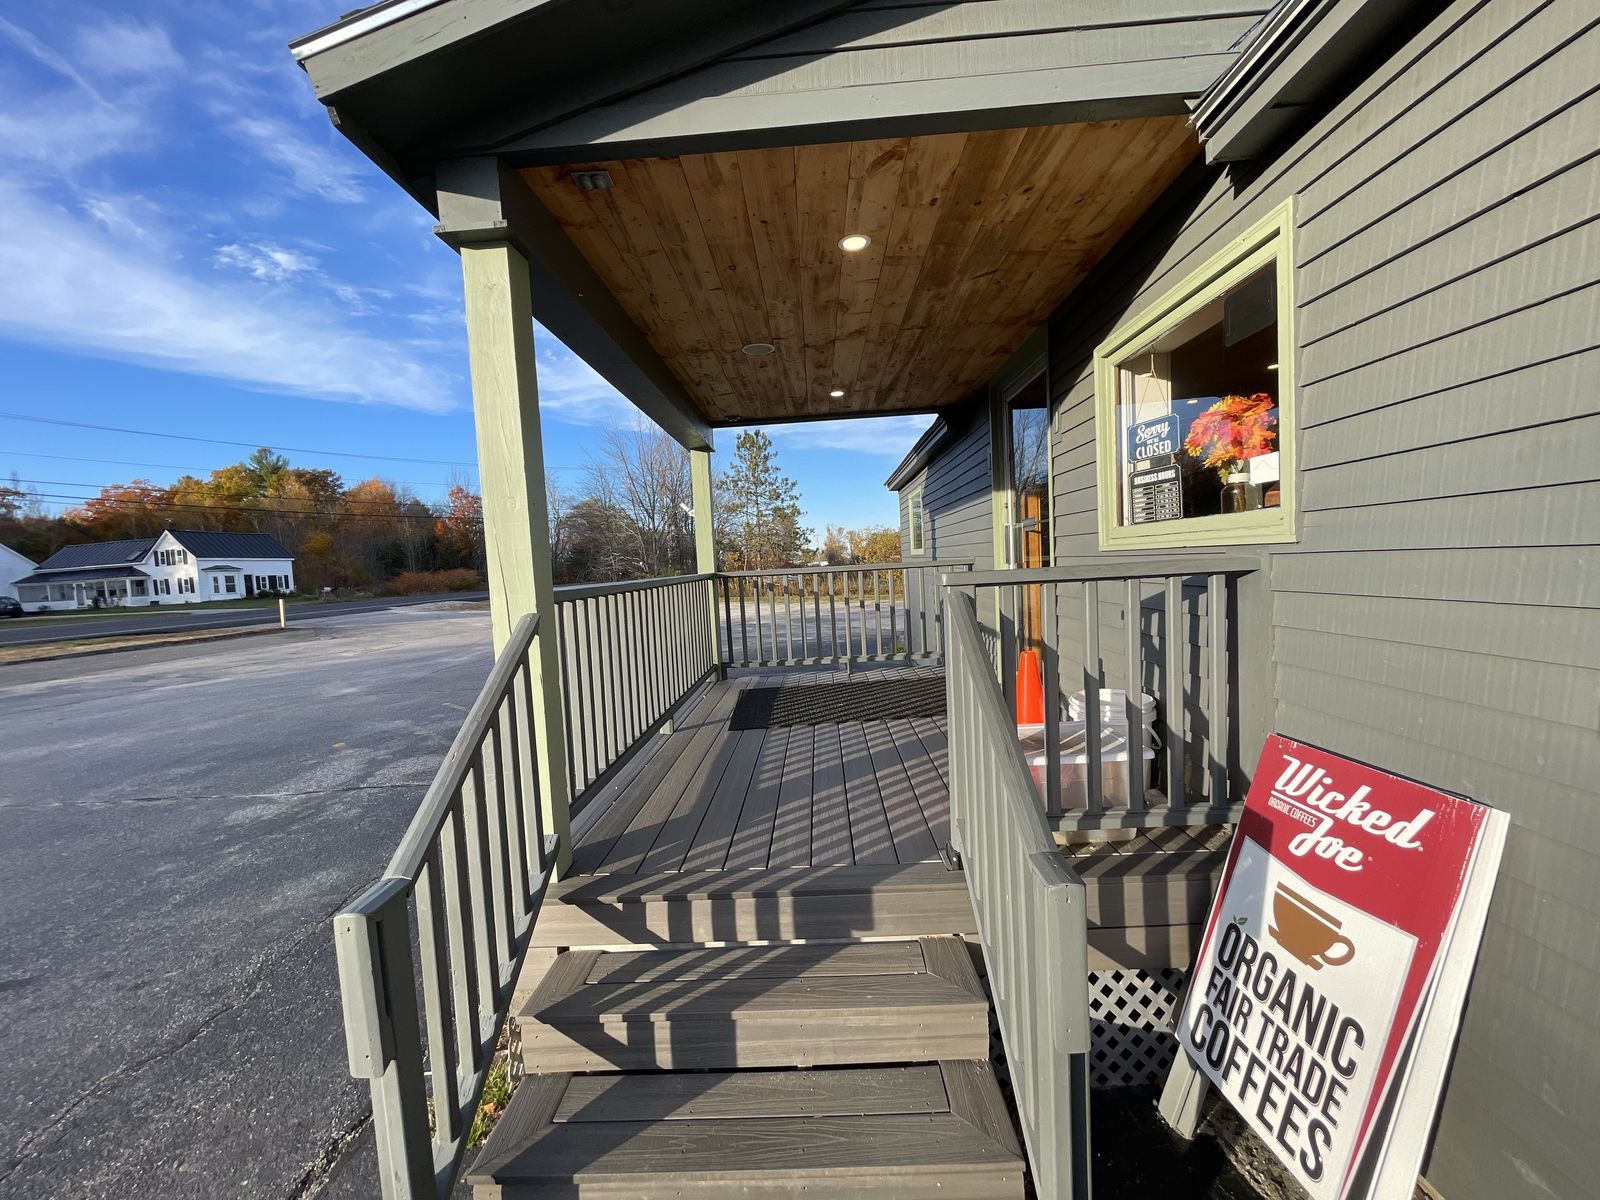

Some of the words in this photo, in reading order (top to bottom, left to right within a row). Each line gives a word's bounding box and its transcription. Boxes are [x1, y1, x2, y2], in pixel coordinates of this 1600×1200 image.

[1136, 422, 1170, 443] Sorry
[1136, 440, 1171, 459] CLOSED
[1134, 473, 1157, 485] BUSINESS
[1157, 469, 1176, 481] HOURS
[1268, 796, 1292, 815] ORGANIC
[1290, 807, 1317, 828] COFFEES
[1275, 754, 1435, 849] Wicked
[1288, 815, 1363, 871] Joe
[1218, 922, 1365, 1078] ORGANIC
[1205, 966, 1253, 1037] FAIR
[1256, 1011, 1349, 1128] TRADE
[1190, 1003, 1333, 1183] COFFEES
